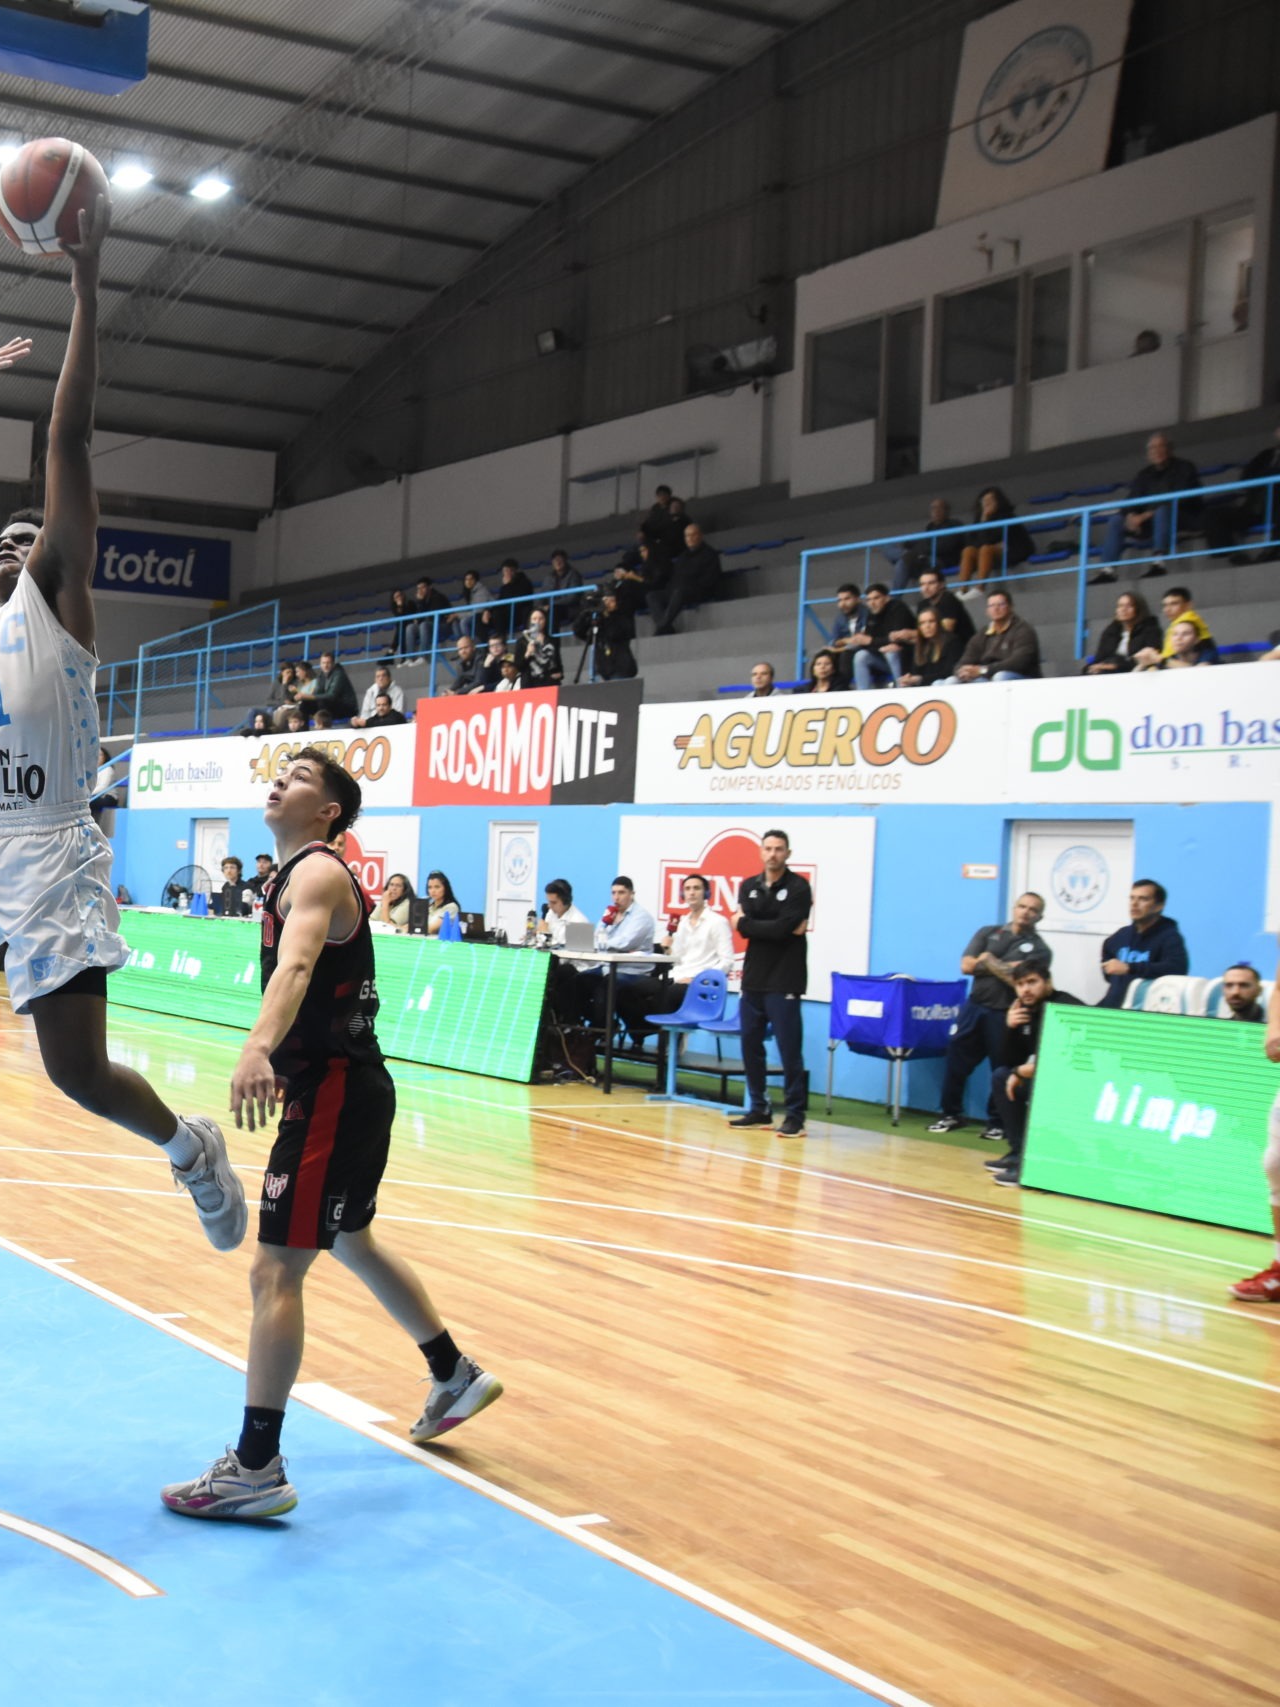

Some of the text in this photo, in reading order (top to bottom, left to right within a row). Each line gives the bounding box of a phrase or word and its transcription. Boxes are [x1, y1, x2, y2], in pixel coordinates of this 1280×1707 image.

[103, 544, 197, 588] total
[250, 736, 391, 783] AGRCO
[429, 702, 618, 794] ROSAMONTE
[675, 699, 958, 769] AGUERCO
[1030, 708, 1121, 772] db
[1130, 714, 1203, 749] don
[164, 763, 184, 781] don
[187, 760, 223, 780] basilio
[710, 769, 902, 791] COMPENSADOS FENÓLICOS
[1094, 1080, 1218, 1144] himpa
